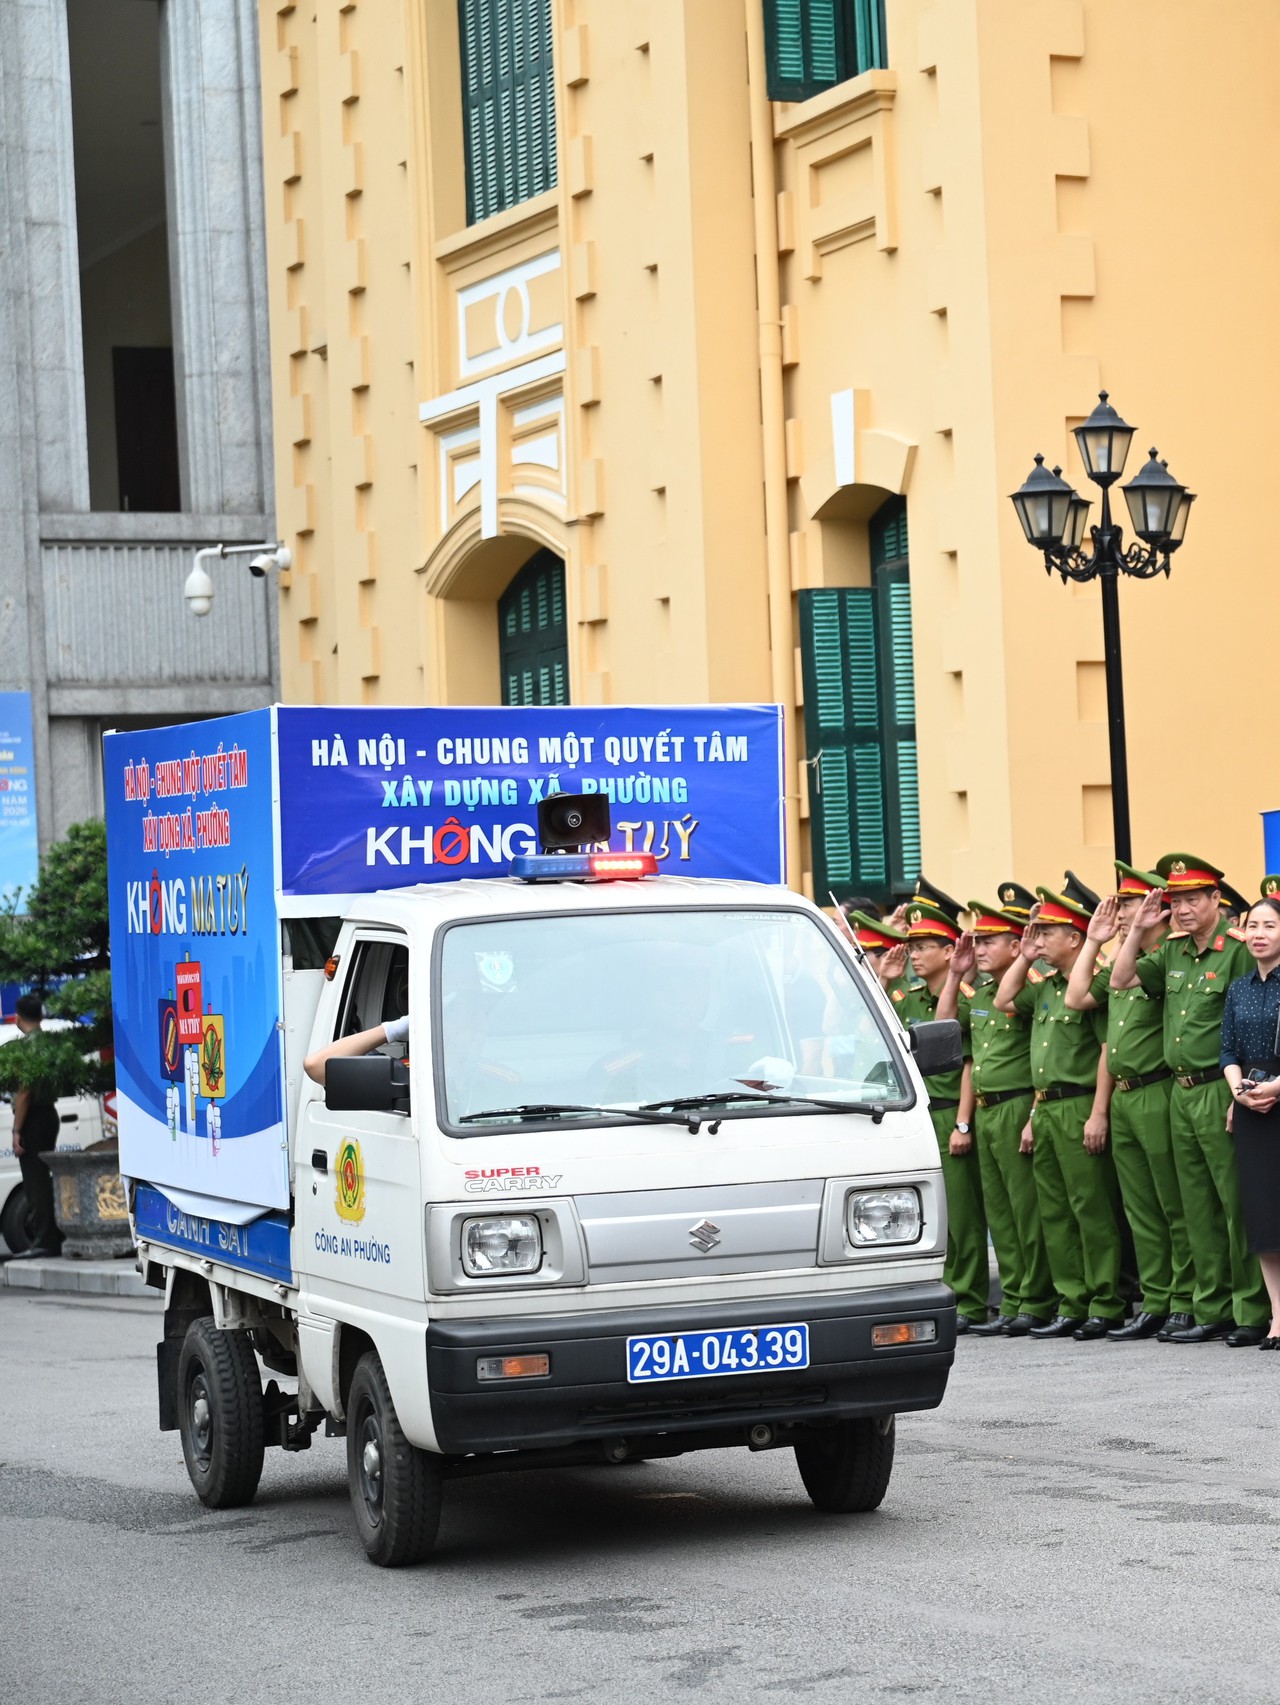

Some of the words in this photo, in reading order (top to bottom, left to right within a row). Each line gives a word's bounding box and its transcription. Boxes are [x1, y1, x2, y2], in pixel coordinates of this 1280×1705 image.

[311, 733, 349, 766] HÀ
[358, 733, 406, 771] NỘI
[437, 737, 529, 765] CHUNG
[538, 731, 595, 769] MỘT
[604, 728, 685, 766] QUYẾT
[693, 730, 748, 763] TÂM
[124, 759, 136, 801] HÀ
[136, 757, 150, 807] NỘI
[155, 759, 182, 798] CHUNG
[182, 750, 201, 802] MỘT
[202, 741, 228, 796] QUYẾT
[228, 743, 248, 789] TÂM
[381, 775, 434, 808] XÂY
[444, 777, 518, 812] DỰNG
[581, 771, 688, 804] PHƯỜNG
[142, 809, 158, 852] XÂY
[158, 811, 180, 859] DỰNG
[181, 806, 196, 853] XÃ,
[196, 801, 230, 849] PHƯỜNG
[366, 816, 537, 866] KHÔNG
[617, 813, 699, 861] TUÝ
[127, 867, 187, 936] KHÔNG
[190, 875, 217, 936] MA
[216, 863, 249, 936] TUÝ
[464, 1166, 540, 1180] SUPER
[464, 1174, 563, 1194] CARRY
[315, 1227, 338, 1255] CÔNG
[340, 1237, 352, 1257] AN
[354, 1235, 391, 1264] PHƯỜNG
[633, 1329, 803, 1377] 29A-043.39
